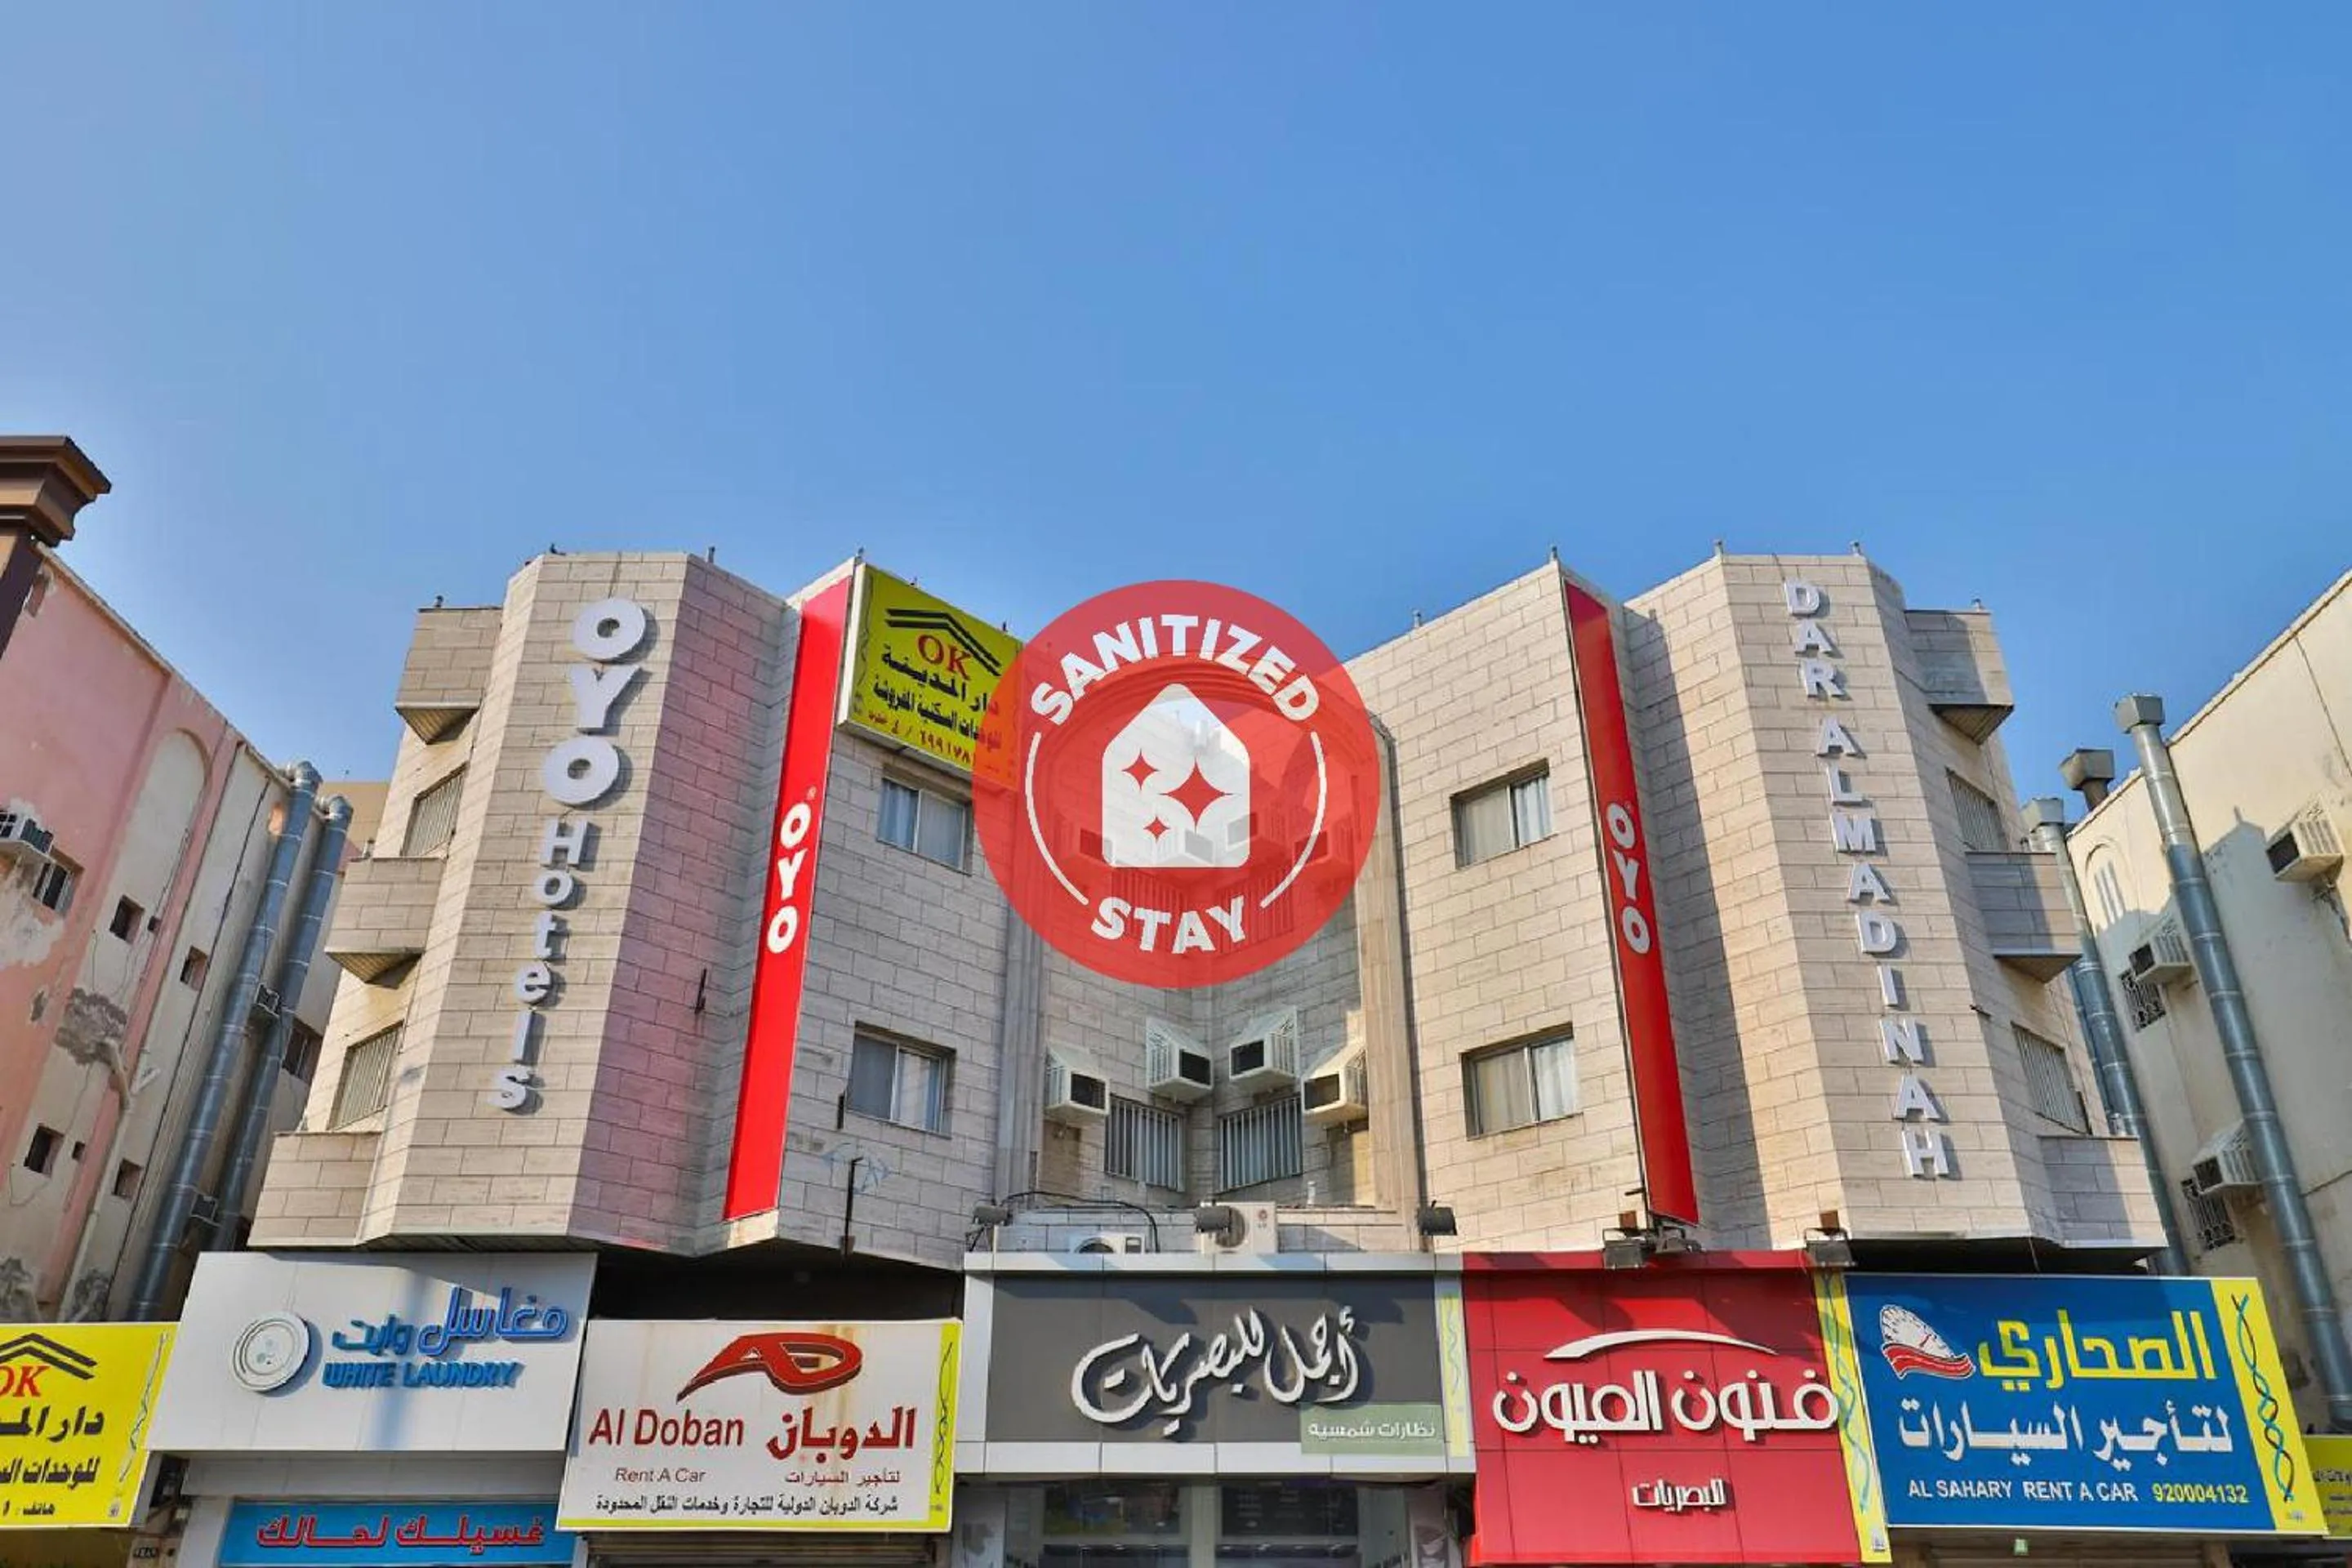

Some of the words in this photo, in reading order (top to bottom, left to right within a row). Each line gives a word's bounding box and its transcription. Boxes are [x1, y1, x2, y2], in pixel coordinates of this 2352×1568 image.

[881, 642, 967, 702] المدينة
[917, 634, 970, 681] OK
[544, 598, 648, 807] OYO
[767, 801, 812, 954] OYO
[1606, 802, 1650, 955] OYO
[491, 820, 589, 1111] Hotels
[332, 1313, 414, 1356] وايت
[417, 1286, 568, 1356] مغاسل
[1979, 1309, 2217, 1392] الصحاري
[323, 1361, 398, 1388] WHITE
[403, 1361, 523, 1388] LAUNDRY
[46, 1405, 105, 1442] دار
[589, 1409, 625, 1446] Al
[634, 1409, 744, 1446] Doban
[766, 1405, 917, 1463] الدوبان
[1378, 1419, 1436, 1439] نظارات
[1898, 1396, 2084, 1468] السيارات
[2092, 1399, 2235, 1472] لتأجير
[22, 1456, 100, 1490] للوحدات
[615, 1467, 653, 1483] Rent
[657, 1468, 671, 1482] A
[675, 1468, 706, 1483] Car
[785, 1470, 849, 1486] السيارات
[1908, 1479, 1929, 1499] AL
[1936, 1479, 2013, 1499] SAHARY
[2022, 1481, 2073, 1501] RENT
[2079, 1481, 2095, 1501] A
[2096, 1482, 2140, 1503] CAR
[2152, 1483, 2249, 1504] 920004132
[866, 1494, 898, 1515] شركة
[395, 1515, 544, 1555] غسيلك
